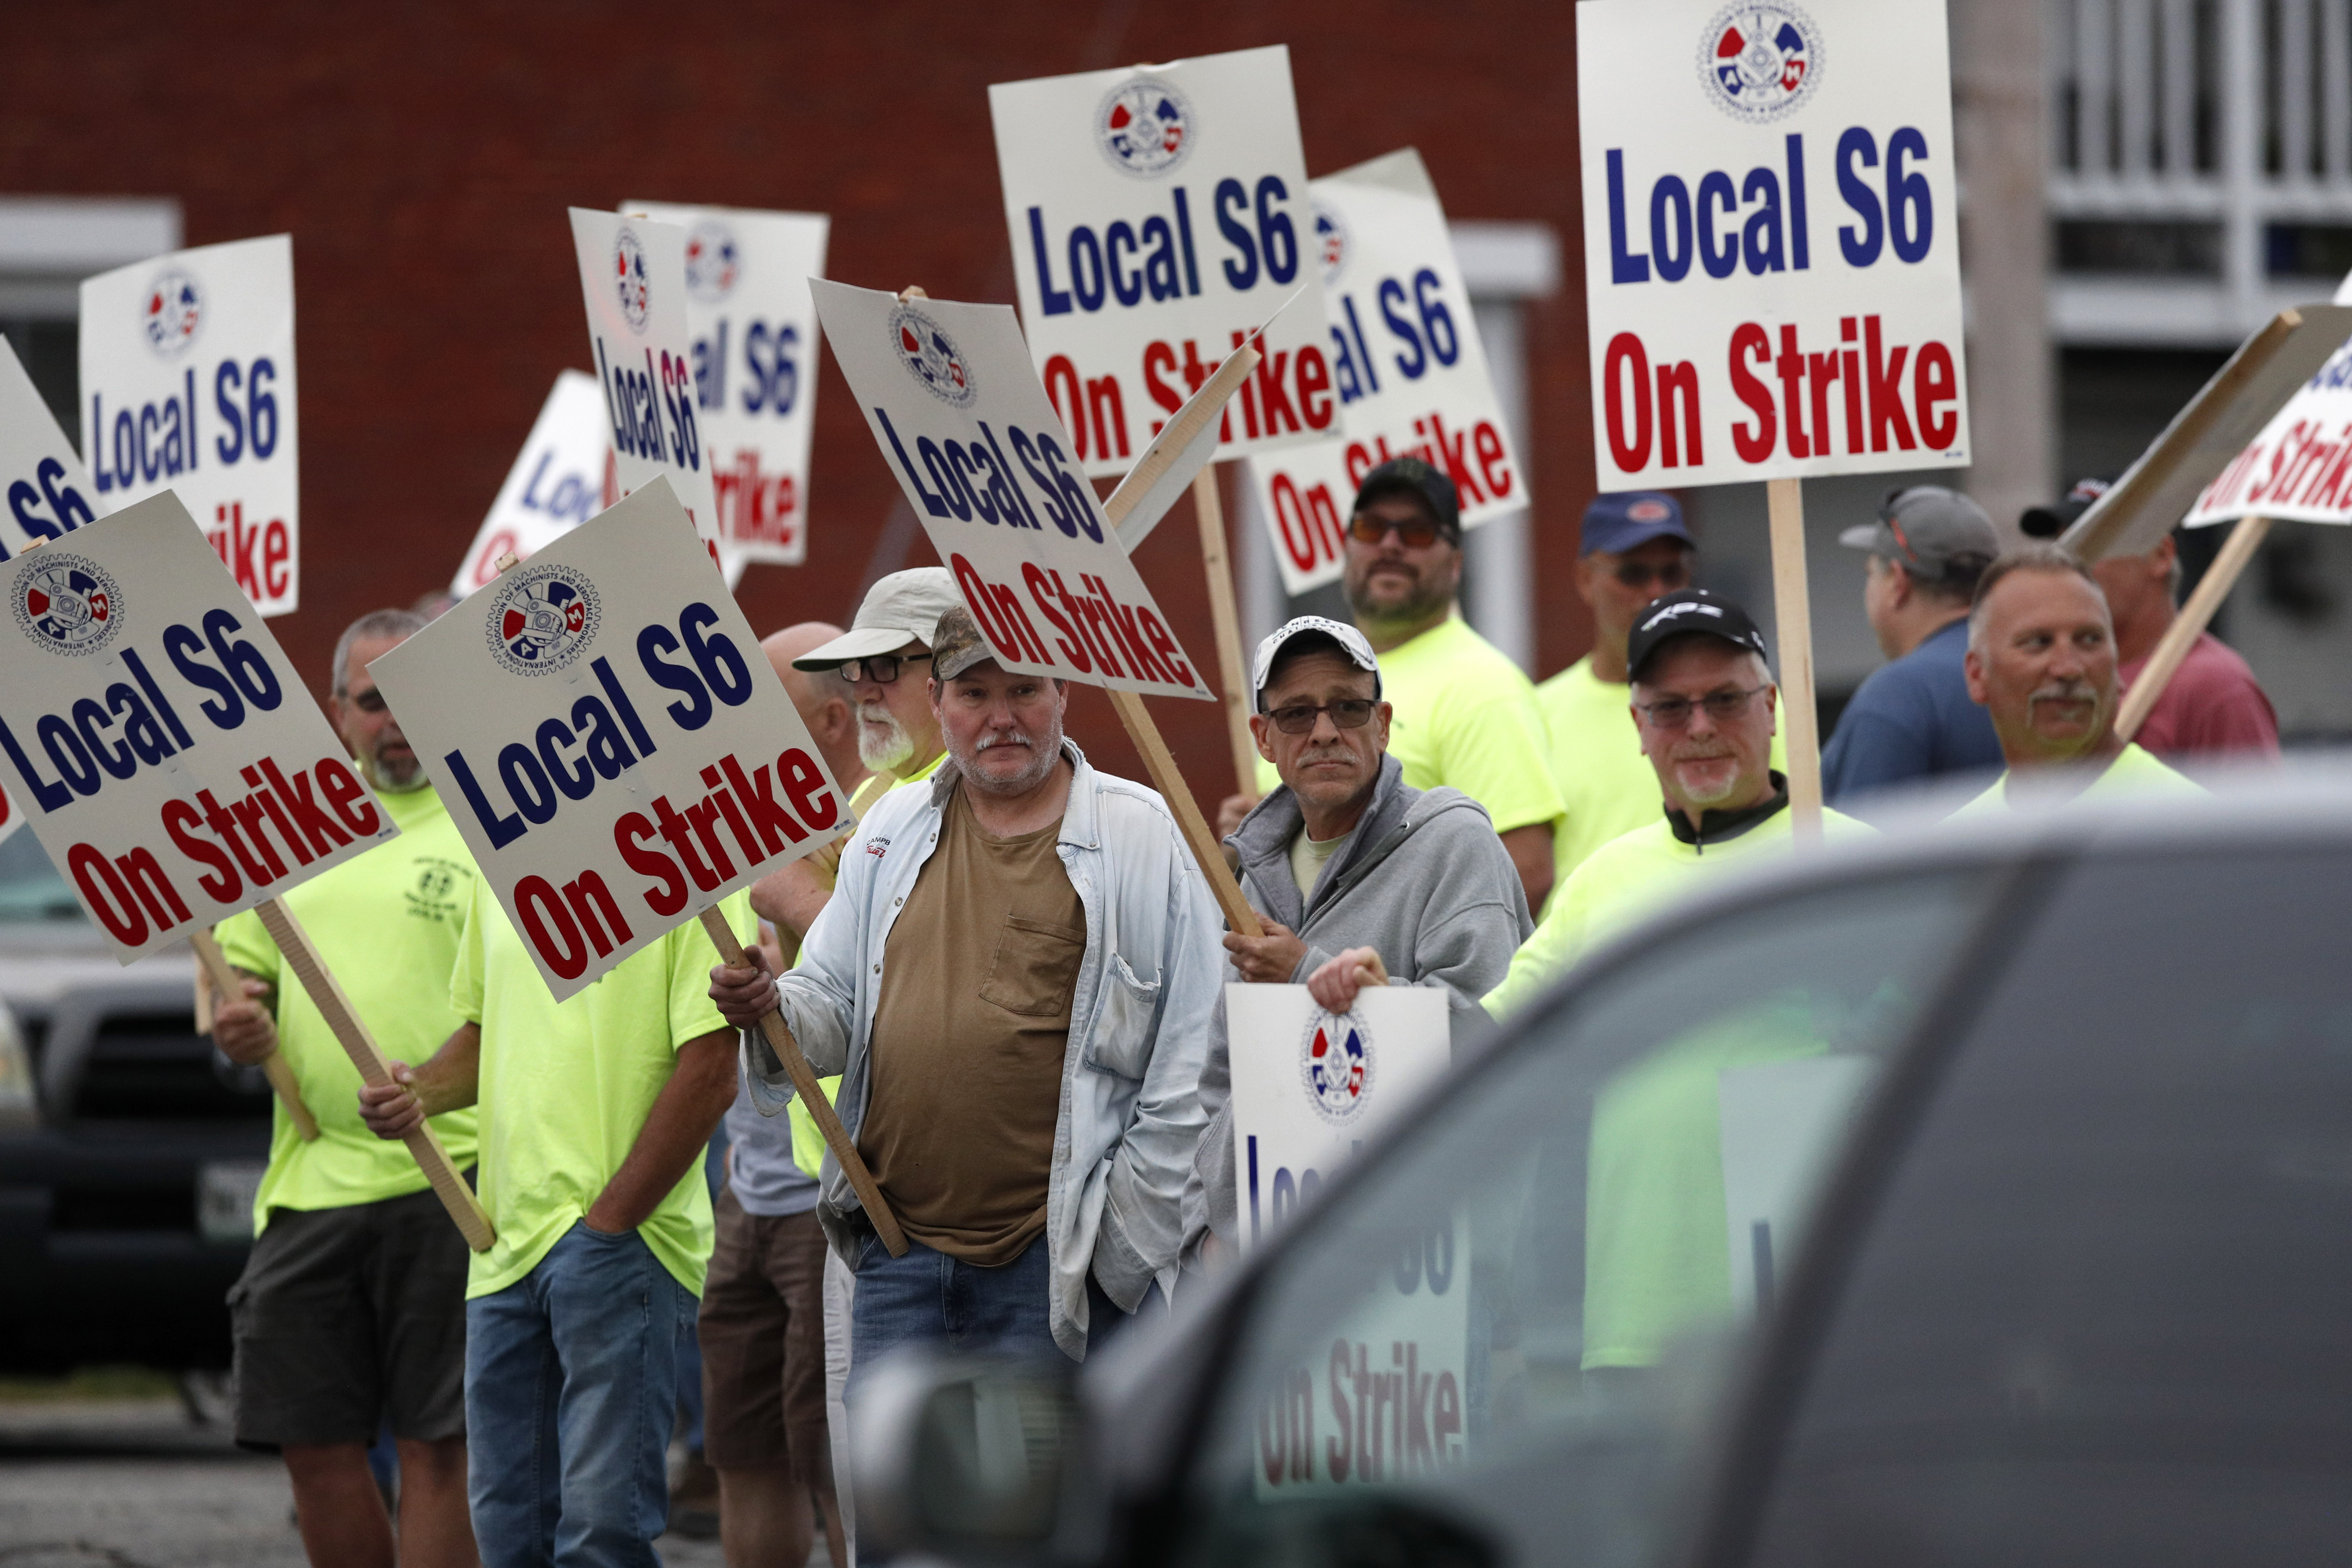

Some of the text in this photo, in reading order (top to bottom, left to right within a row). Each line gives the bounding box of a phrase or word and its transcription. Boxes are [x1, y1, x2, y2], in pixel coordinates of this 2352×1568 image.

[1028, 187, 1202, 317] Local
[1214, 175, 1299, 291] S6
[1605, 125, 1933, 285] Local S6
[742, 320, 799, 416] S6
[1377, 267, 1461, 380] S6
[94, 358, 278, 493] Local S6
[597, 337, 700, 472] Local S6
[1043, 354, 1131, 462] On
[1143, 330, 1334, 444] Stike
[1603, 314, 1958, 474] On Strike
[873, 407, 1105, 544] Local S6
[1270, 472, 1347, 573] On
[19, 581, 32, 624] ASSOCIATION
[36, 561, 78, 573] MACHINISTS
[80, 565, 95, 576] AND
[94, 615, 116, 642] WORKERS
[95, 576, 116, 612] AEROSPACE
[494, 573, 593, 668] INTERNATIONAL ASSOCIATION OF MACHINISTS AND AEROSPACE WORKERS
[950, 552, 1197, 689] On Strike
[31, 625, 84, 649] INTERNATIONAL
[0, 609, 282, 813] Local S6
[444, 603, 753, 850] Local S6
[67, 843, 193, 946] On
[161, 756, 380, 904] Strike
[514, 870, 634, 980] On
[614, 748, 838, 916] Strike
[1326, 1336, 1461, 1484] Strike
